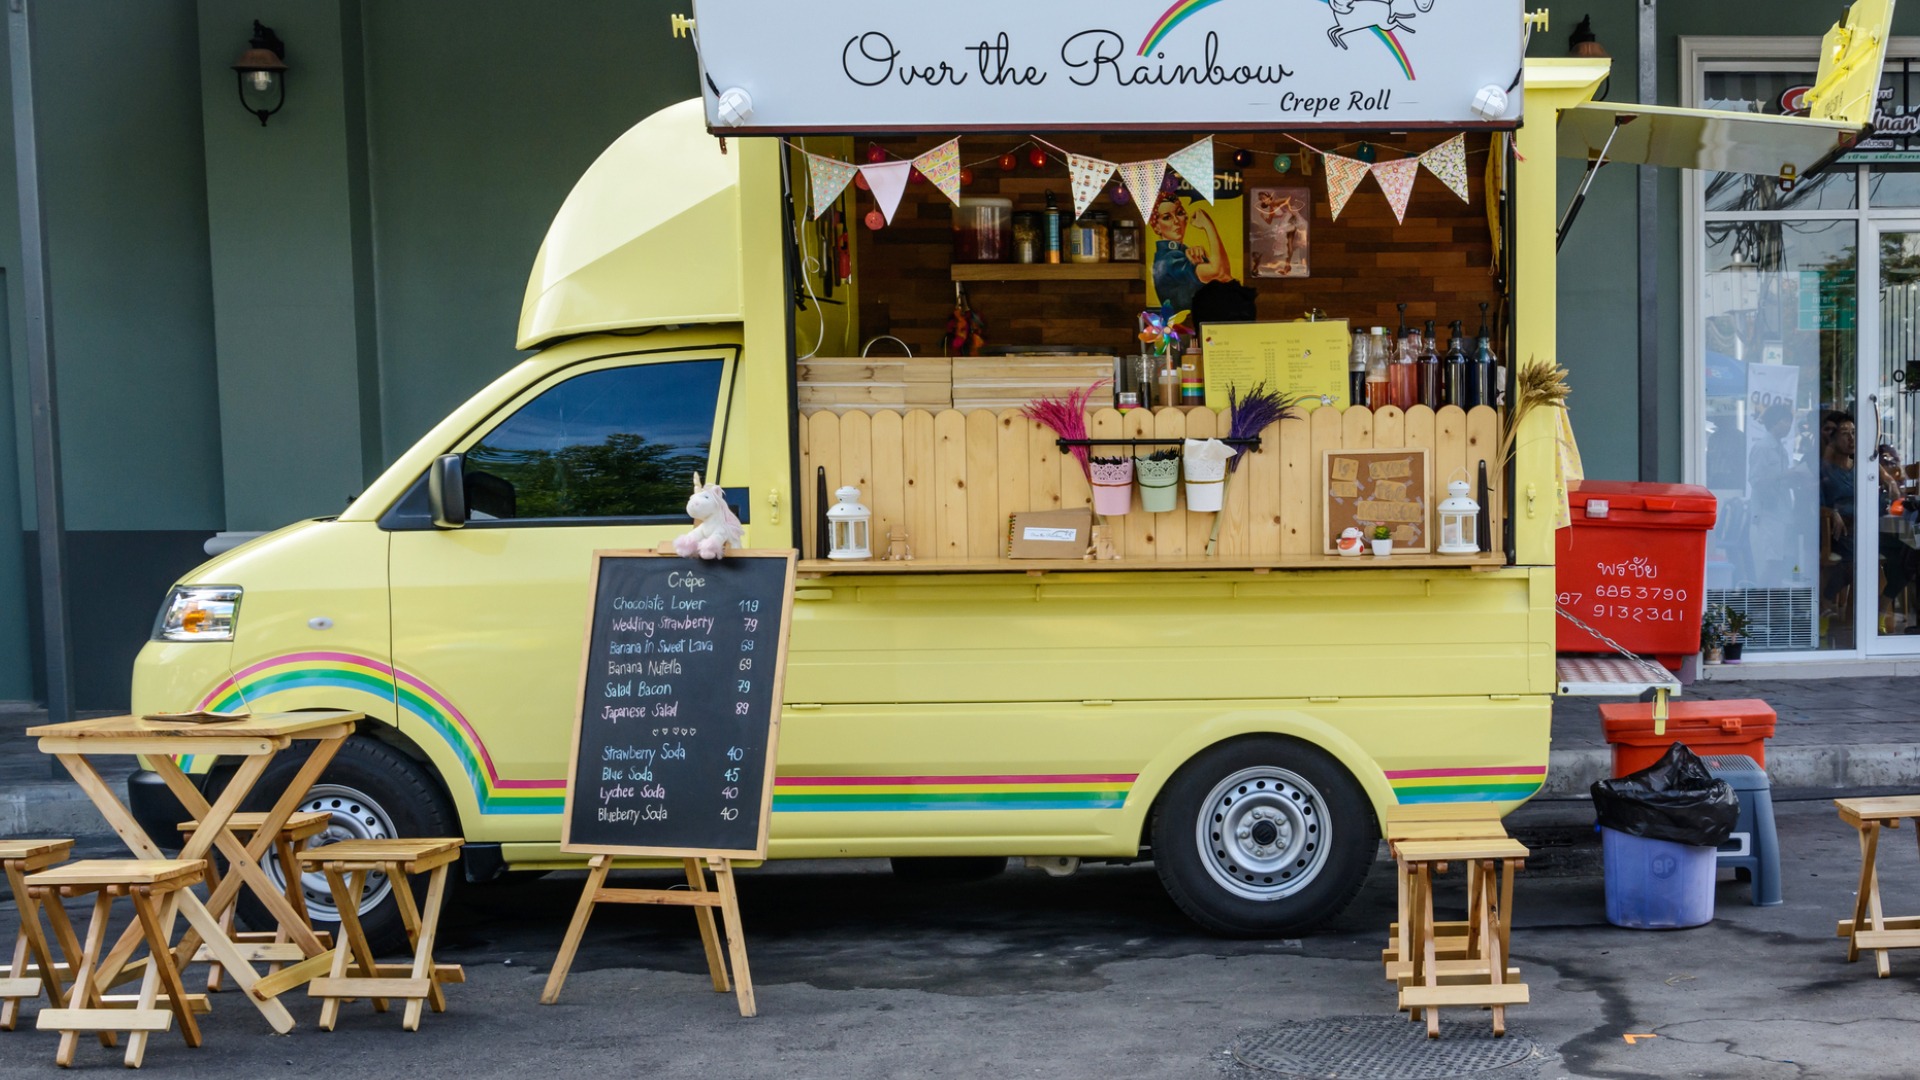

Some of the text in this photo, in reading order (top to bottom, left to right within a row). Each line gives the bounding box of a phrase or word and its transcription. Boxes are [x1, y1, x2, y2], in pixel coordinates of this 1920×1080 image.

[842, 29, 1294, 86] Over the Rainbow
[1280, 89, 1391, 117] Crepe Roll
[1597, 557, 1657, 578] พรชัย
[668, 571, 706, 592] Crêpe
[613, 594, 759, 613] Chocolate Lover 119
[1596, 585, 1687, 601] 6853790
[612, 615, 758, 637] Wedding Strawberry 79
[609, 639, 754, 655] Banana in Sweet Lava 69
[608, 658, 752, 676] Banana Nutella 69
[604, 680, 751, 698] Salad Bacon 79
[601, 701, 749, 724] Japanese Salad 89
[602, 742, 743, 766] Strawberry Soda 40
[602, 766, 741, 782] Blue Soda 45
[600, 784, 738, 805] Lychee Soda 40
[598, 804, 738, 825] Blueberry Soda 40
